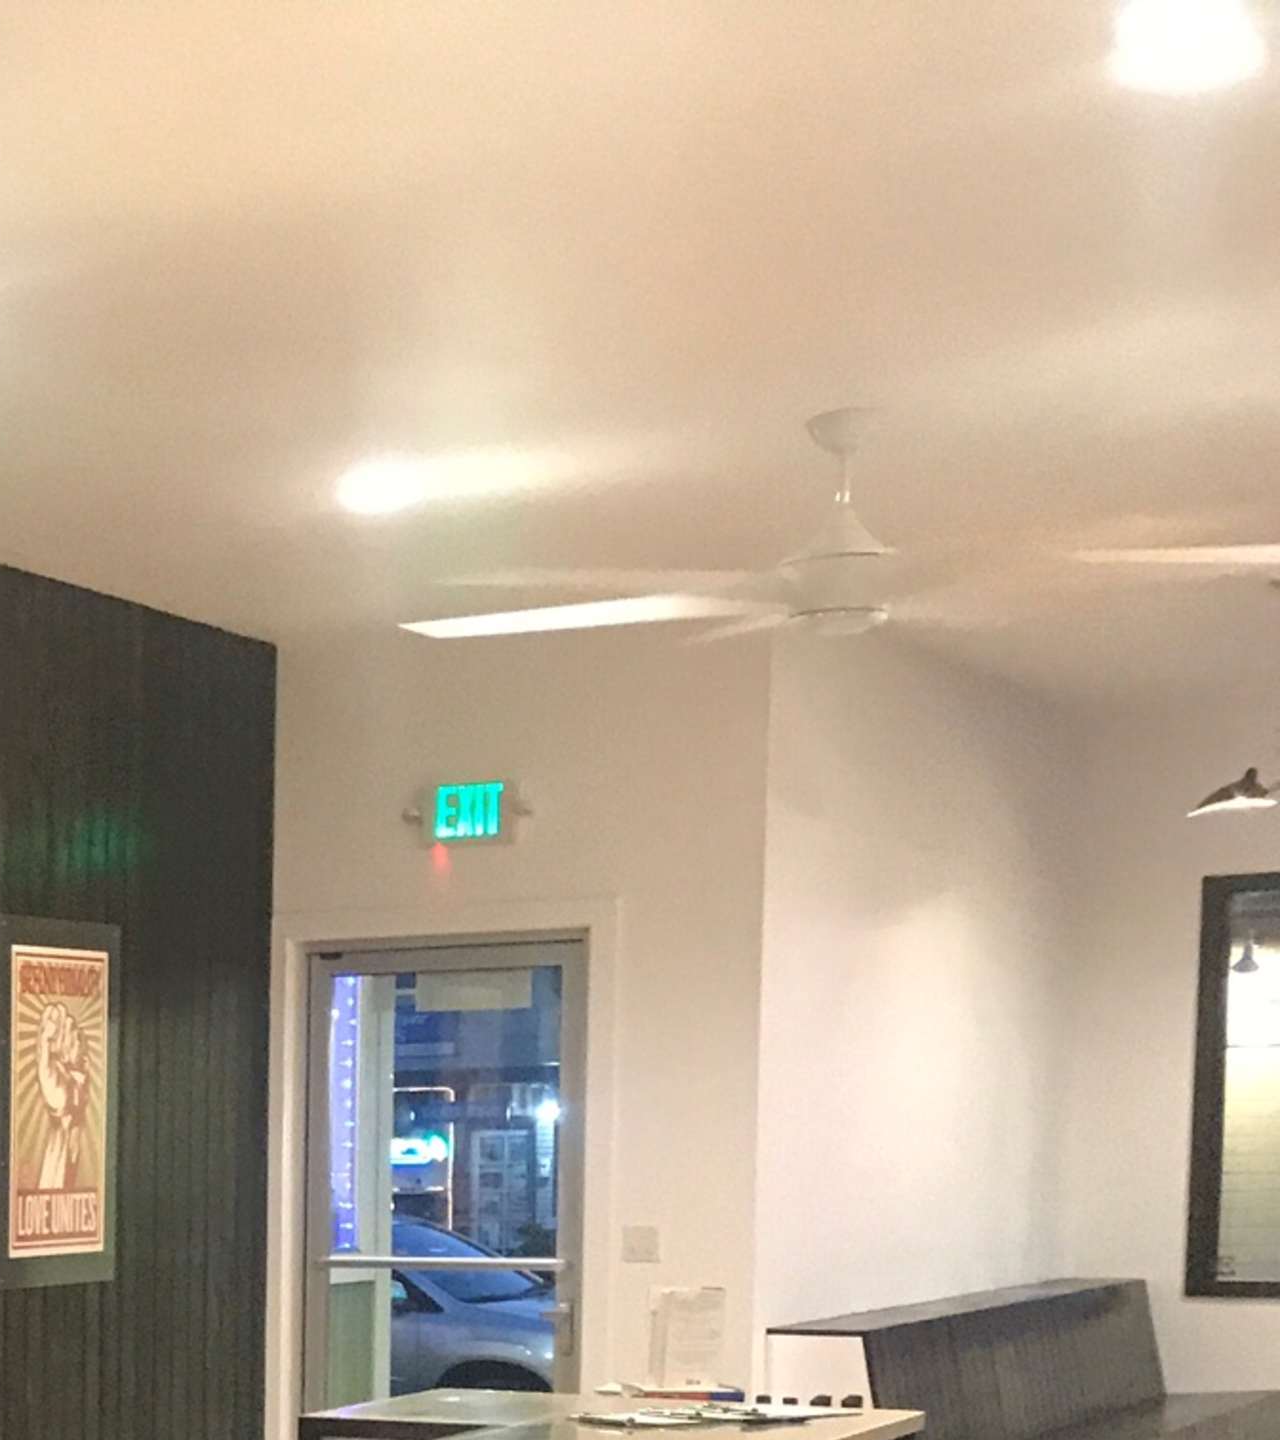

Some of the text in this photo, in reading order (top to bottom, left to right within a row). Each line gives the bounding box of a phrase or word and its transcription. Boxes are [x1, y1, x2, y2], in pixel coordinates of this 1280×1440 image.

[435, 783, 504, 838] EXIT
[17, 1192, 97, 1236] LOVE UNITES
